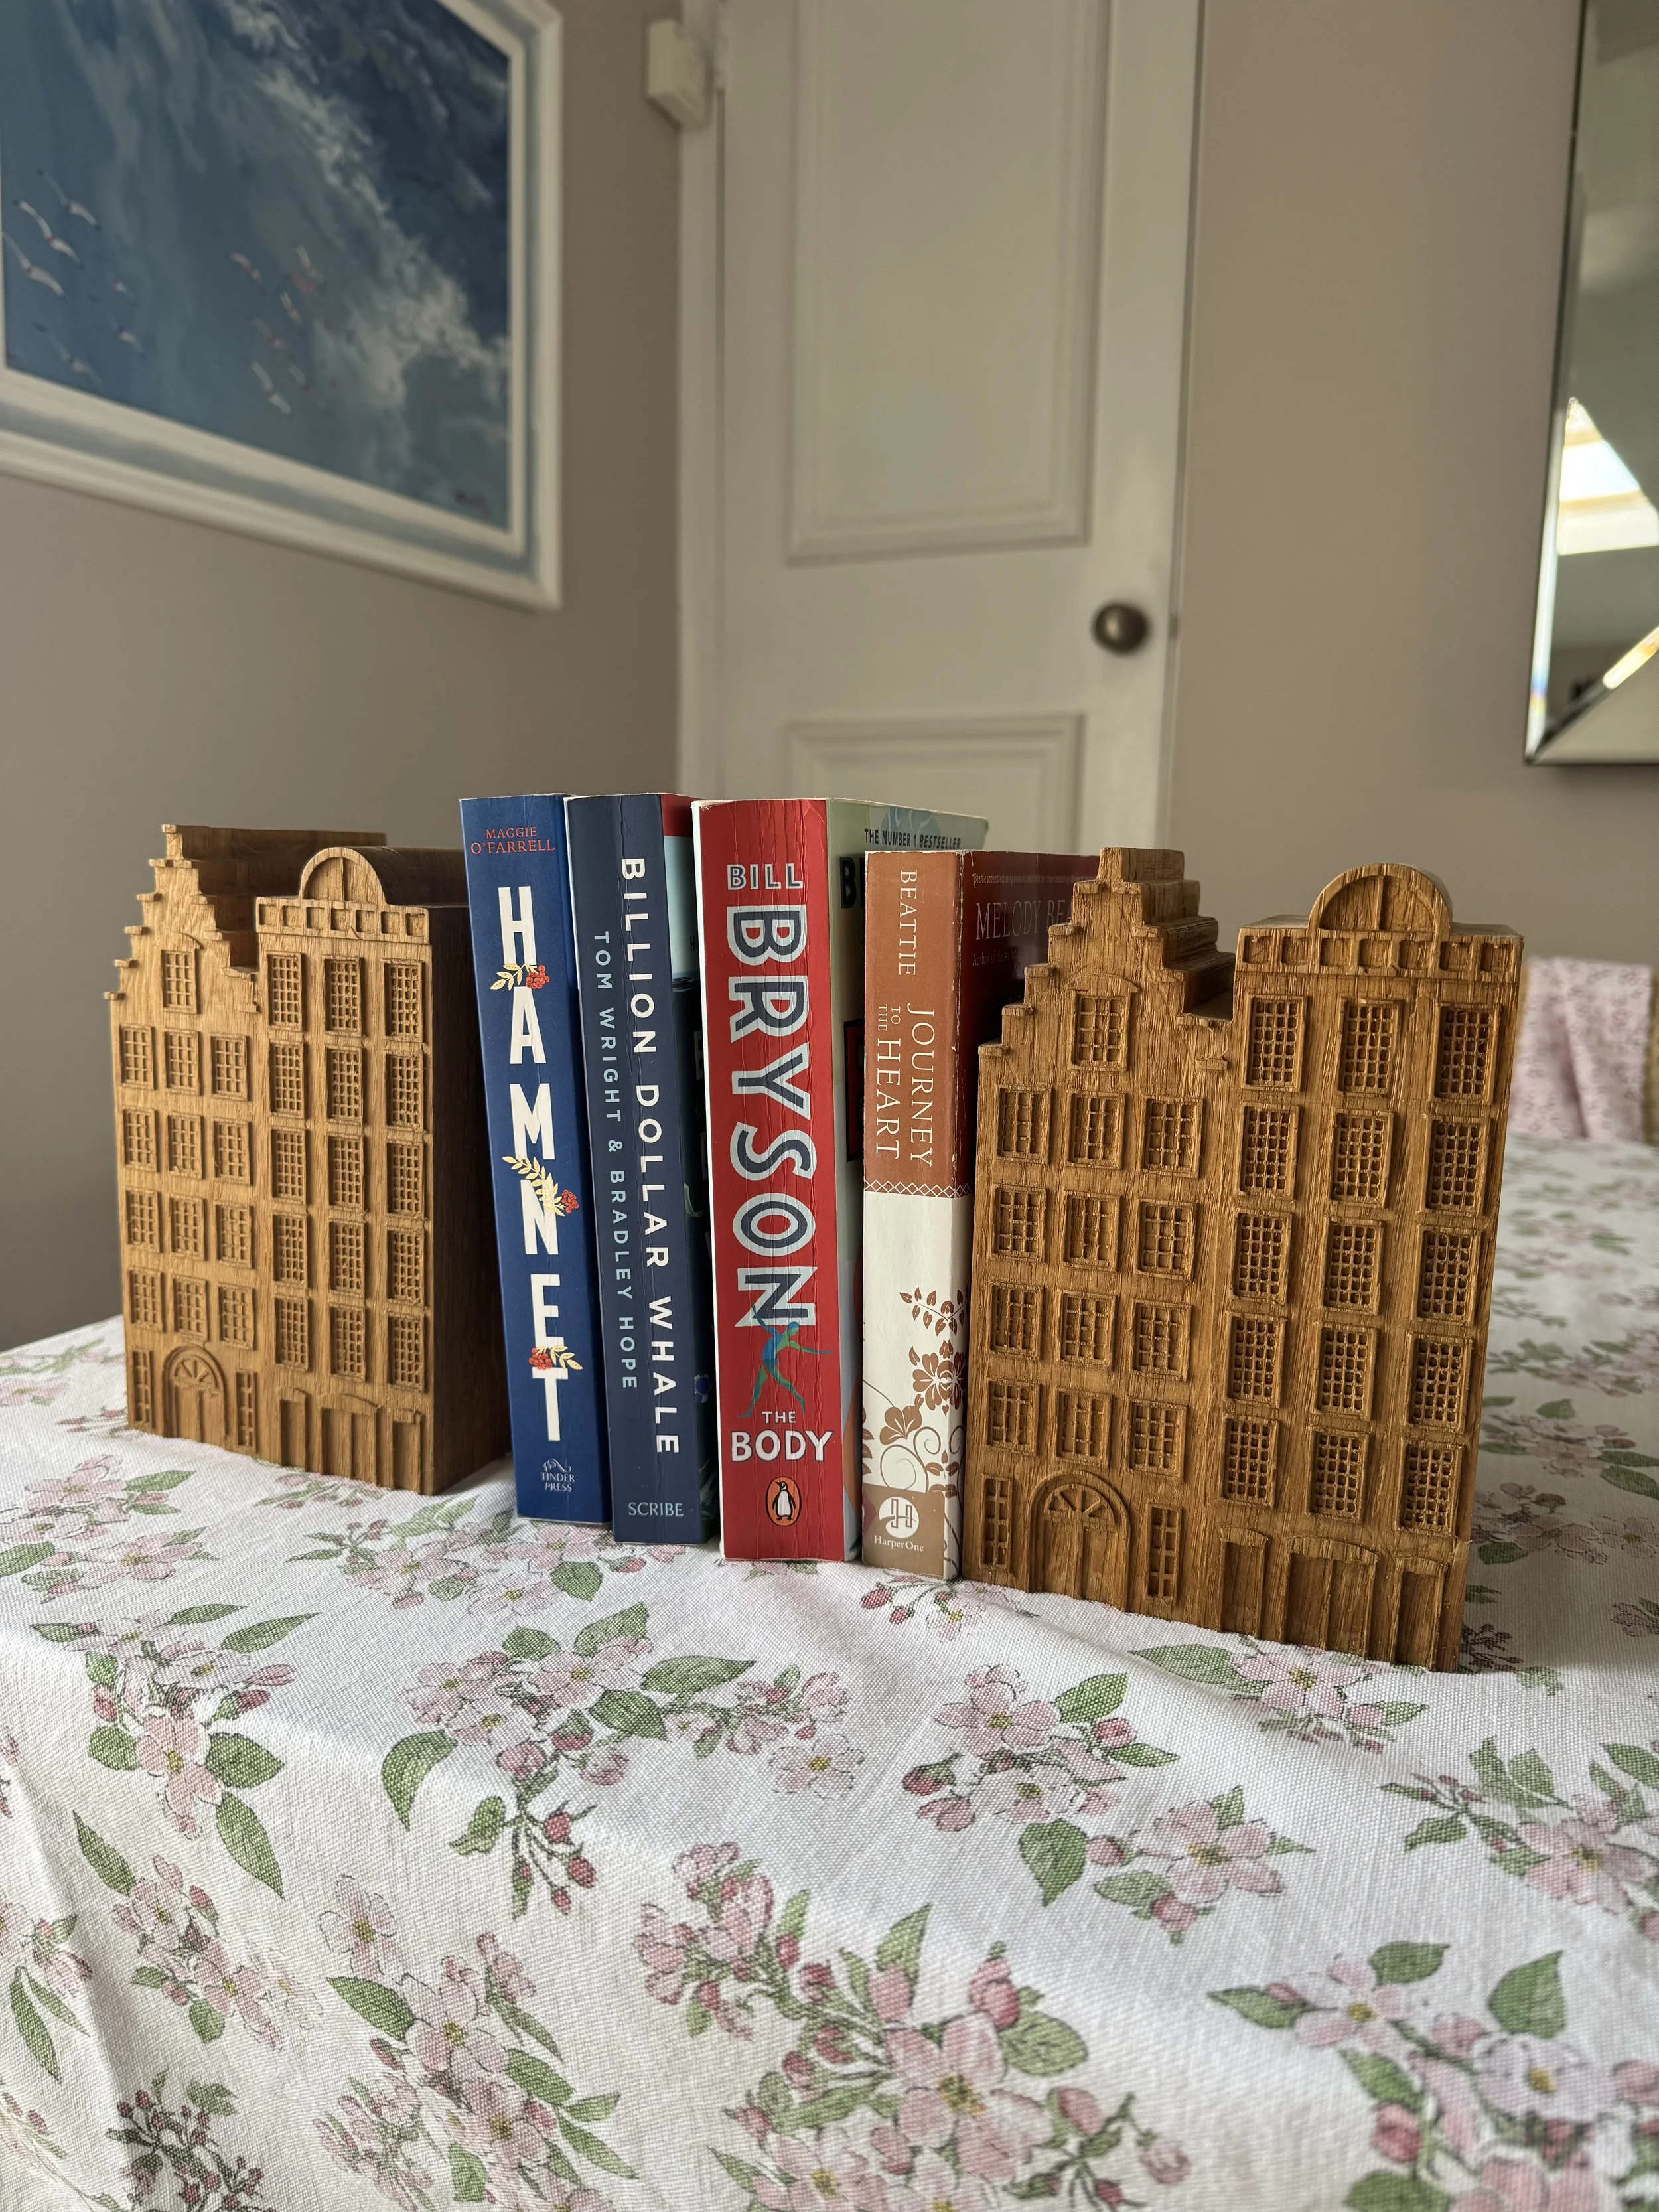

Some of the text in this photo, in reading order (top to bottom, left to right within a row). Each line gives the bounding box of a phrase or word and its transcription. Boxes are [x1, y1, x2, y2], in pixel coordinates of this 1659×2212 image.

[470, 839, 555, 855] O'FARRELL
[485, 826, 537, 840] MAGGIE
[864, 828, 962, 849] THE NUMBER 1 BESTSELLER
[727, 863, 804, 891] BILL
[899, 870, 918, 977] BEATTIE
[975, 899, 1041, 940] MELODY
[972, 952, 990, 966] Author
[878, 1003, 889, 1032] THE
[891, 1005, 901, 1025] TO
[876, 1037, 901, 1160] HEART
[906, 1003, 936, 1166] JOURNEY
[726, 904, 818, 1327] BRYSON
[498, 885, 569, 1441] HAMNET
[593, 930, 638, 1388] TOM WRIGHT & BRADLEY HOPE
[621, 857, 680, 1453] BILLION DOLLAR WHALE
[761, 1410, 796, 1424] THE
[730, 1430, 835, 1463] BODY
[541, 1472, 575, 1483] TINDER
[545, 1482, 573, 1492] PRESS
[628, 1501, 684, 1517] SCRIBE
[874, 1535, 924, 1552] HarperOne
